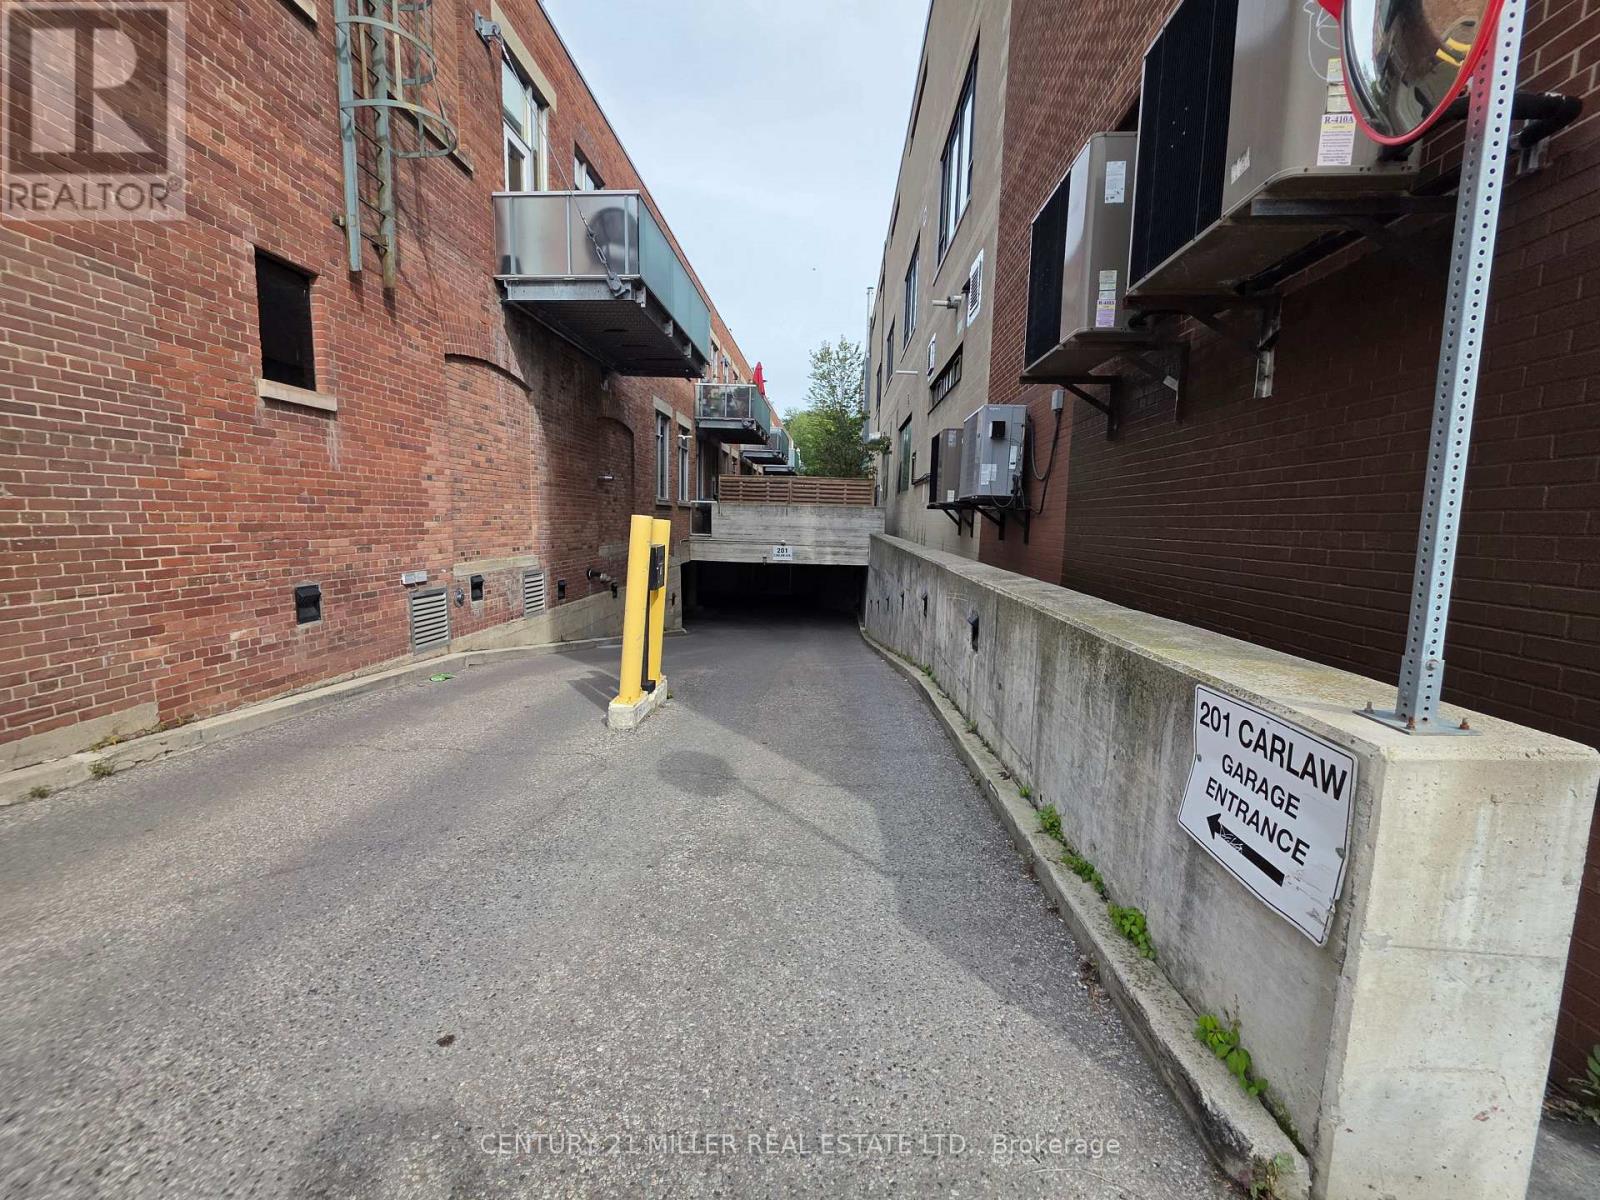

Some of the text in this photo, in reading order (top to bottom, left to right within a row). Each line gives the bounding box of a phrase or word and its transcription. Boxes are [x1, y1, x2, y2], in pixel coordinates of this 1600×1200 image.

[1324, 115, 1354, 125] R-410A
[1199, 701, 1348, 801] 201 CARLAW
[1221, 754, 1301, 820] GARAGE
[1205, 776, 1311, 867] ENTRANCE
